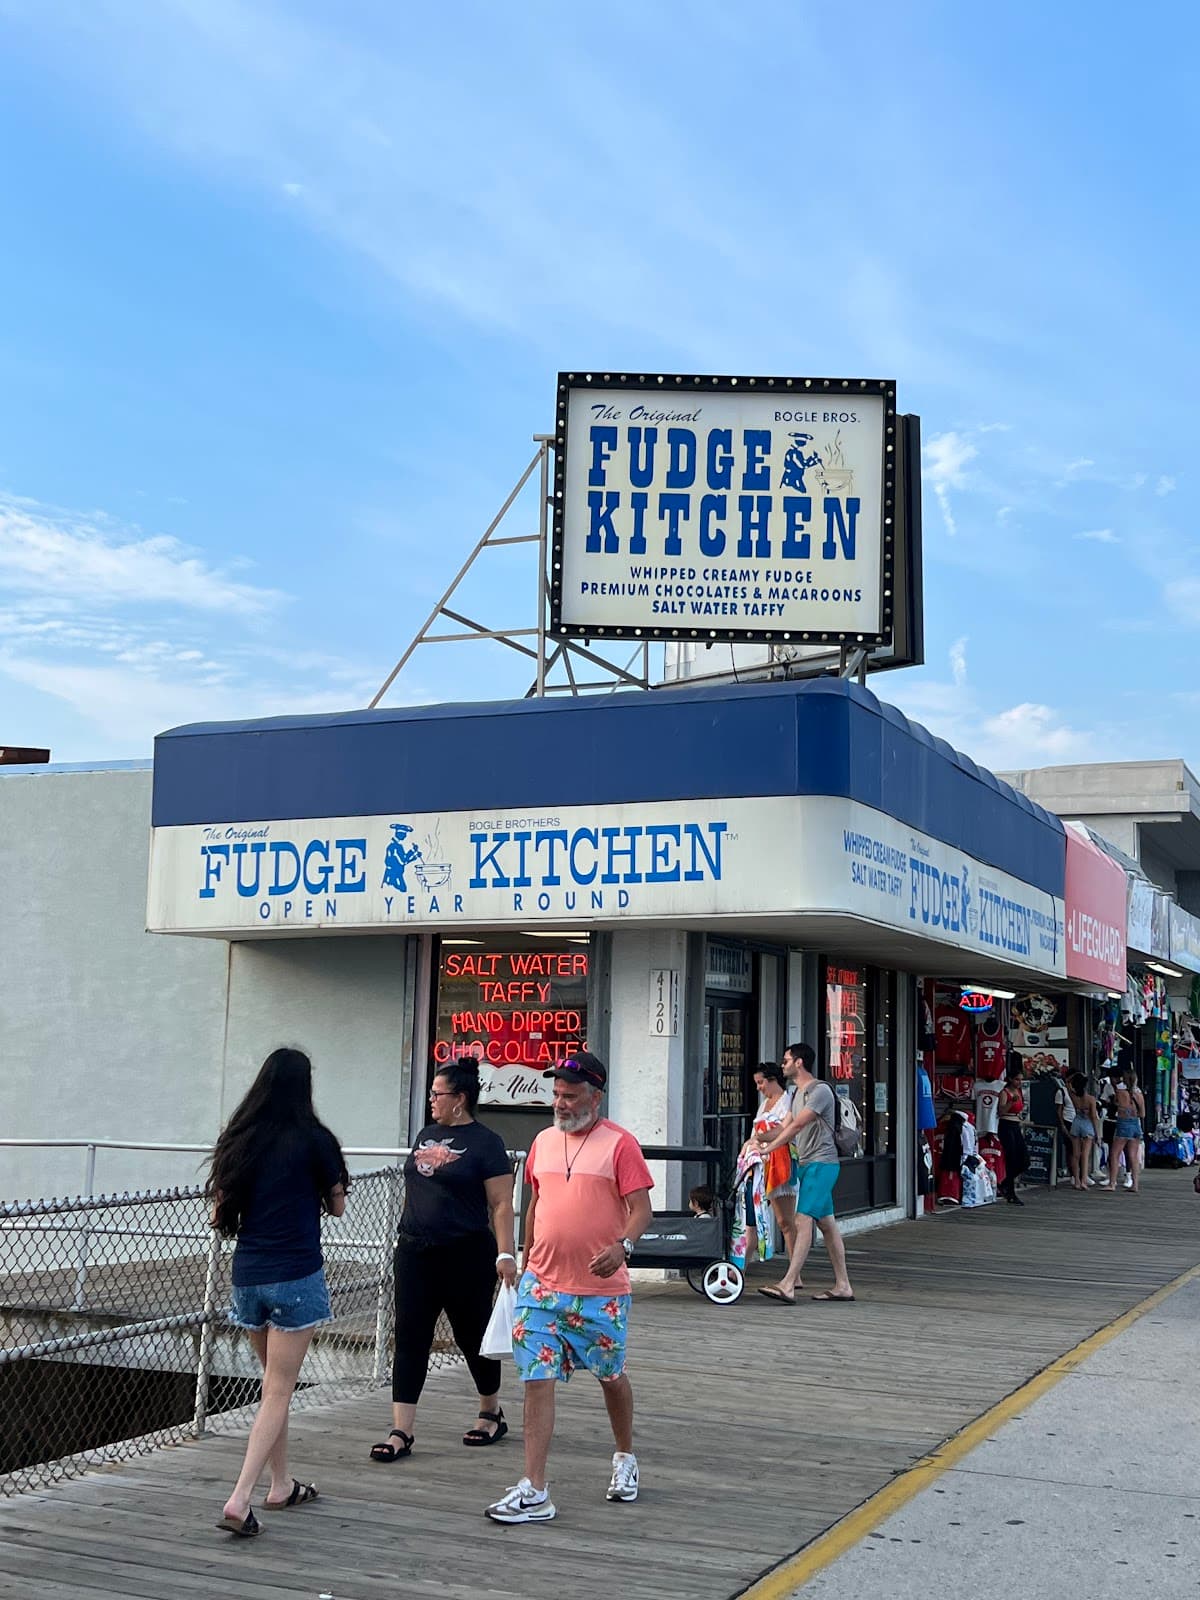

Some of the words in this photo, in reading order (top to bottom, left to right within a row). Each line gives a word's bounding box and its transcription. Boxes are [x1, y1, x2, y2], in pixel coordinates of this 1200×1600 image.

[590, 404, 622, 420] The
[629, 405, 702, 425] Original
[774, 411, 818, 423] BOGLE
[822, 412, 861, 423] BROS.
[588, 425, 772, 491] FUDGE
[585, 490, 861, 560] KITCHEN
[630, 566, 696, 581] WHIPPED
[702, 568, 759, 582] CREAMY
[765, 569, 813, 584] FUDGE
[580, 581, 649, 597] PREMIUM
[655, 584, 747, 600] CHOCOLATES
[752, 587, 762, 600] &
[768, 587, 862, 602] MACAROONS
[651, 600, 686, 614] SALT
[690, 602, 738, 616] WATER
[743, 603, 785, 617] TAFFY
[203, 828, 222, 840] The
[224, 825, 269, 842] Original
[469, 820, 503, 830] BOGLE
[505, 817, 561, 829] BROTHERS
[843, 829, 872, 860] WHIPPED
[199, 838, 367, 898] FUDGE
[469, 821, 727, 888] KITCHEN
[851, 861, 867, 886] SALT
[868, 866, 887, 892] WATER
[887, 873, 903, 897] TAFFY
[259, 899, 337, 919] OPEN
[384, 894, 464, 915] YEAR
[513, 889, 630, 911] ROUND
[909, 856, 960, 932] FUDGE
[978, 887, 1031, 956] KITCHEN
[1072, 909, 1121, 967] LIFEGUARD
[446, 954, 502, 976] SALT
[509, 954, 588, 976] WATER
[479, 981, 550, 1003] TAFFY
[655, 971, 664, 1034] 4120
[959, 993, 993, 1007] ATM
[451, 1011, 504, 1033] HAND
[511, 1011, 581, 1032] DIPPED
